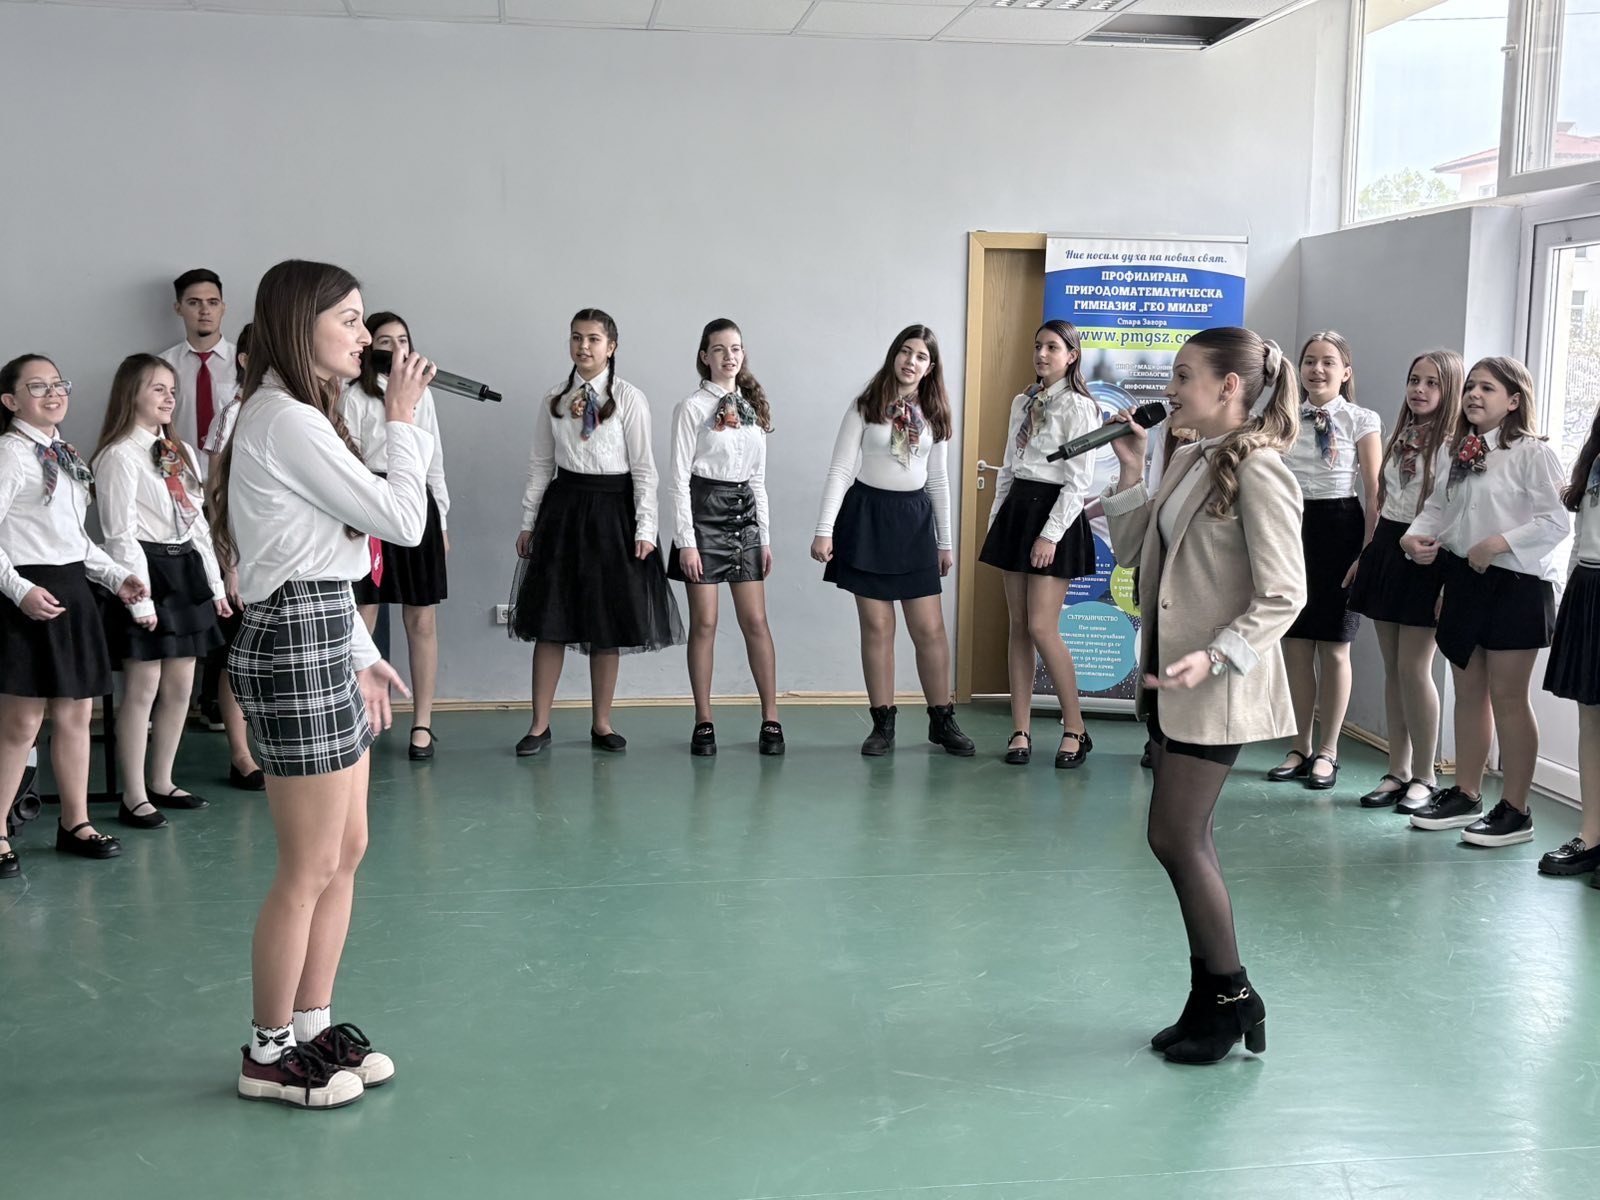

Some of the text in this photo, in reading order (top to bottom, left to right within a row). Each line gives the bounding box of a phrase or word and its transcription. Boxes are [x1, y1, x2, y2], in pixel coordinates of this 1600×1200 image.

[1065, 250, 1228, 263] Ние носим духа на новия свят.
[1101, 270, 1188, 283] ПРОФИЛИРАНА
[1065, 285, 1223, 299] ПРИРОДОМАТЕМАТИЧЕСКА
[1073, 300, 1137, 312] ГИМНАЗИЯ
[1138, 301, 1165, 313] „ГЕО
[1117, 317, 1168, 327] Стара Загора
[1078, 331, 1191, 346] www.pmgsz.co
